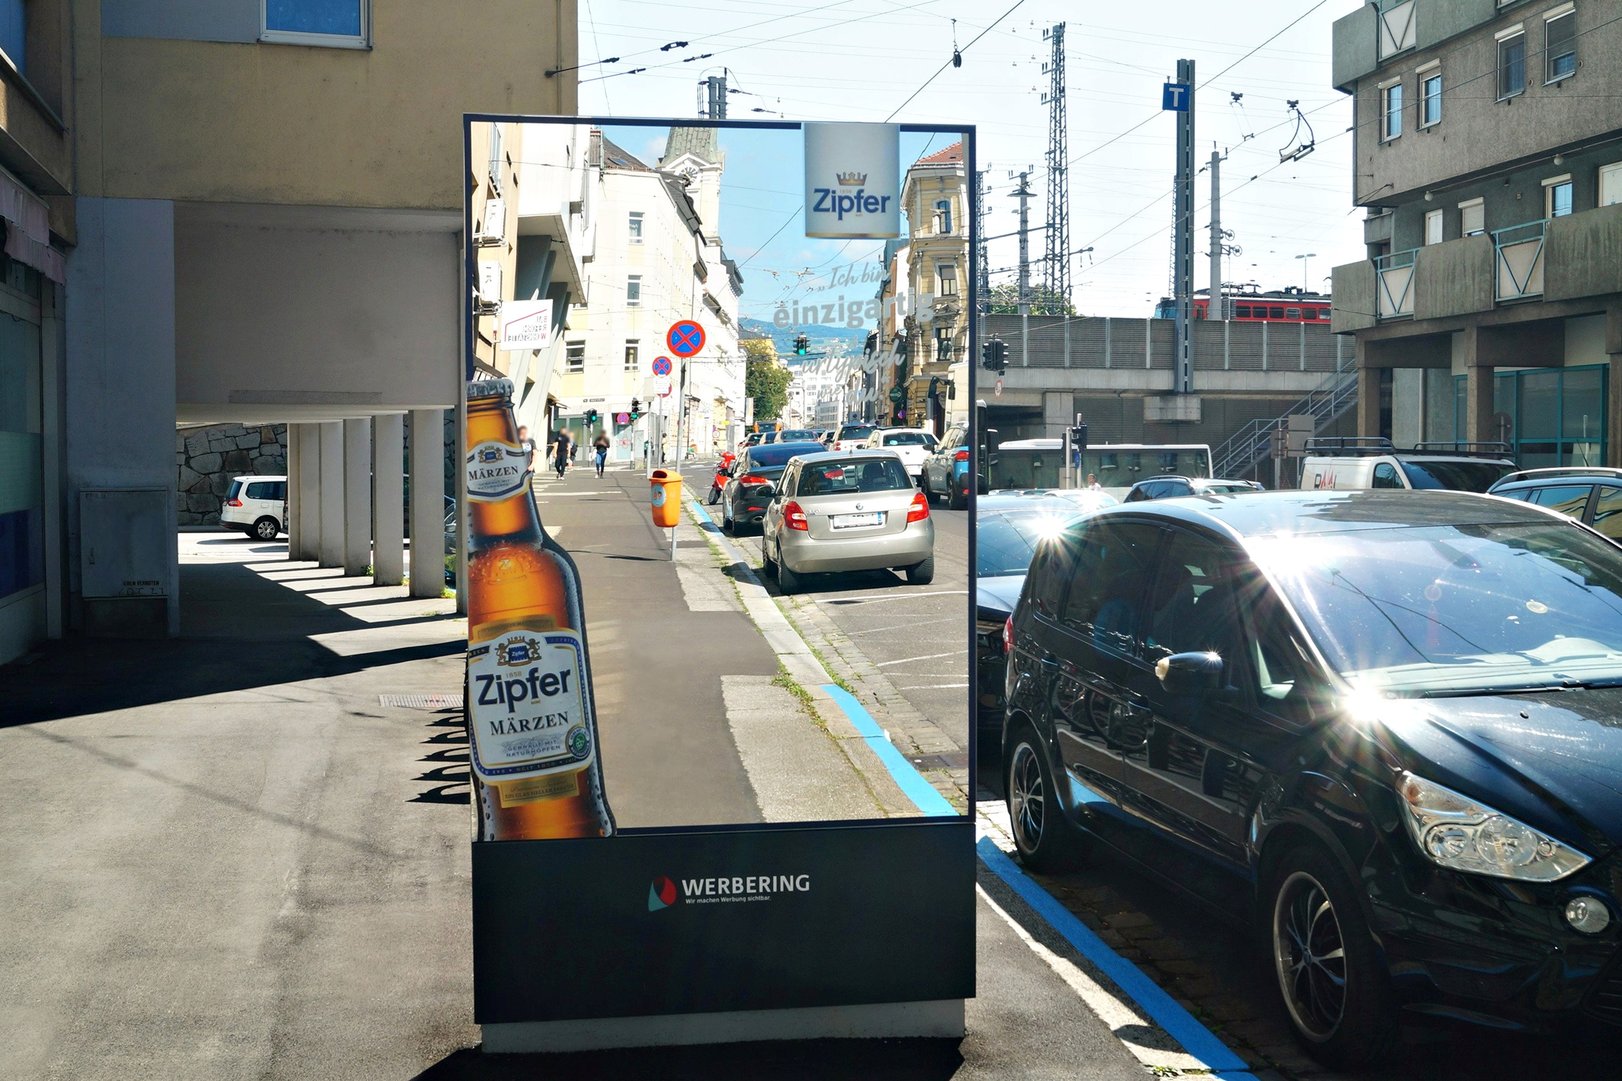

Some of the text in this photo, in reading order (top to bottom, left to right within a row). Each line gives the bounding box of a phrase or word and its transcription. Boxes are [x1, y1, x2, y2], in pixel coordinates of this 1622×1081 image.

[1168, 87, 1185, 107] T
[812, 187, 891, 221] Zipfer
[861, 261, 889, 284] bin
[773, 287, 935, 329] einzigartig
[468, 465, 519, 481] MÄRZEN
[475, 667, 571, 714] Zipfer
[490, 711, 569, 736] MÄRZEN
[682, 874, 810, 896] WERBERING
[721, 895, 746, 903] Werbung
